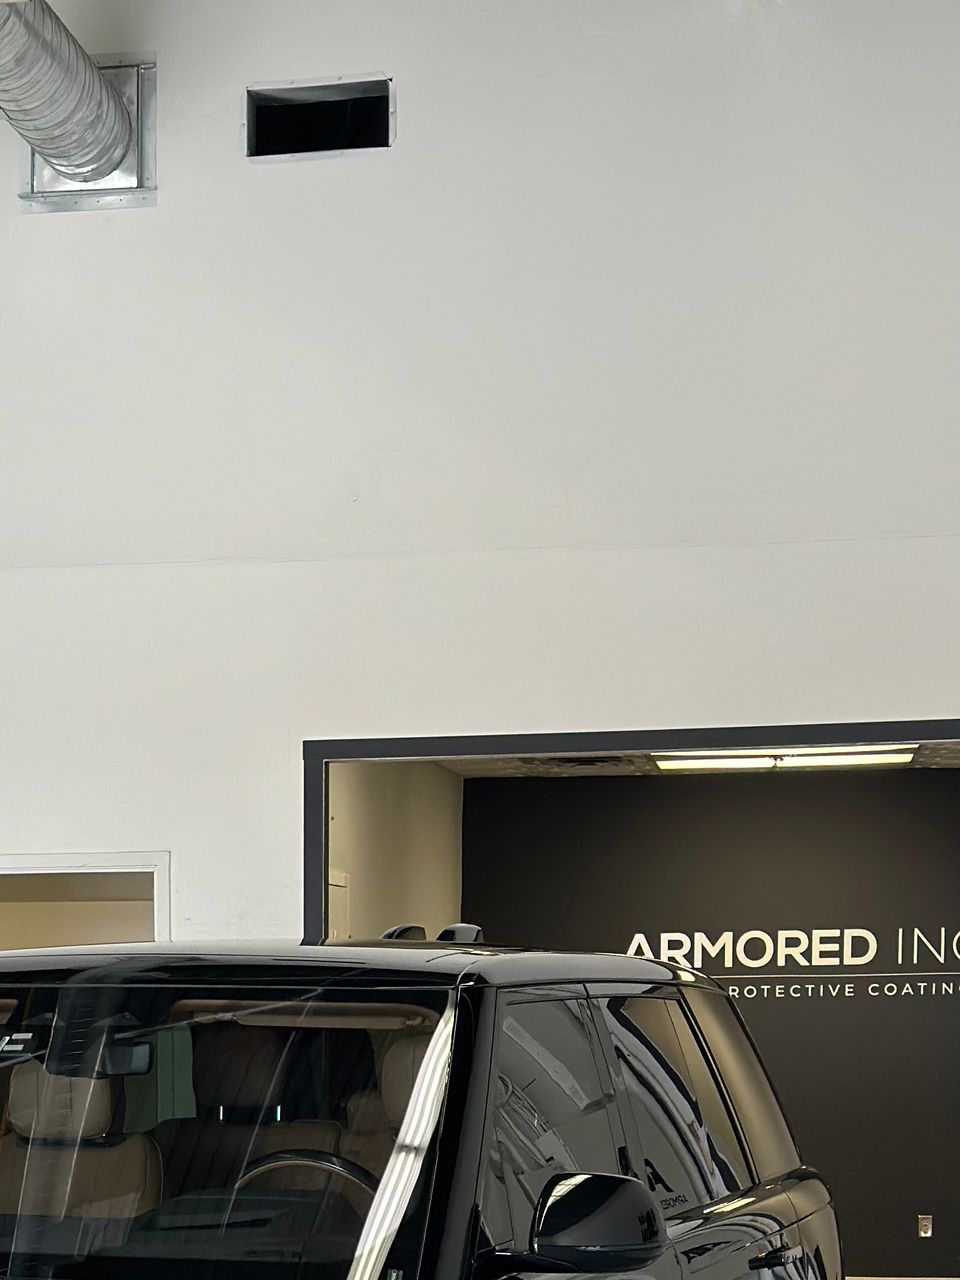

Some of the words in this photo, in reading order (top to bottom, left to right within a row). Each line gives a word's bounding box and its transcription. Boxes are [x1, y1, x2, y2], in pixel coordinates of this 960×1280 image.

[626, 929, 878, 969] ARMORED
[728, 983, 855, 999] ROTECTIVE
[868, 982, 960, 997] COATIN
